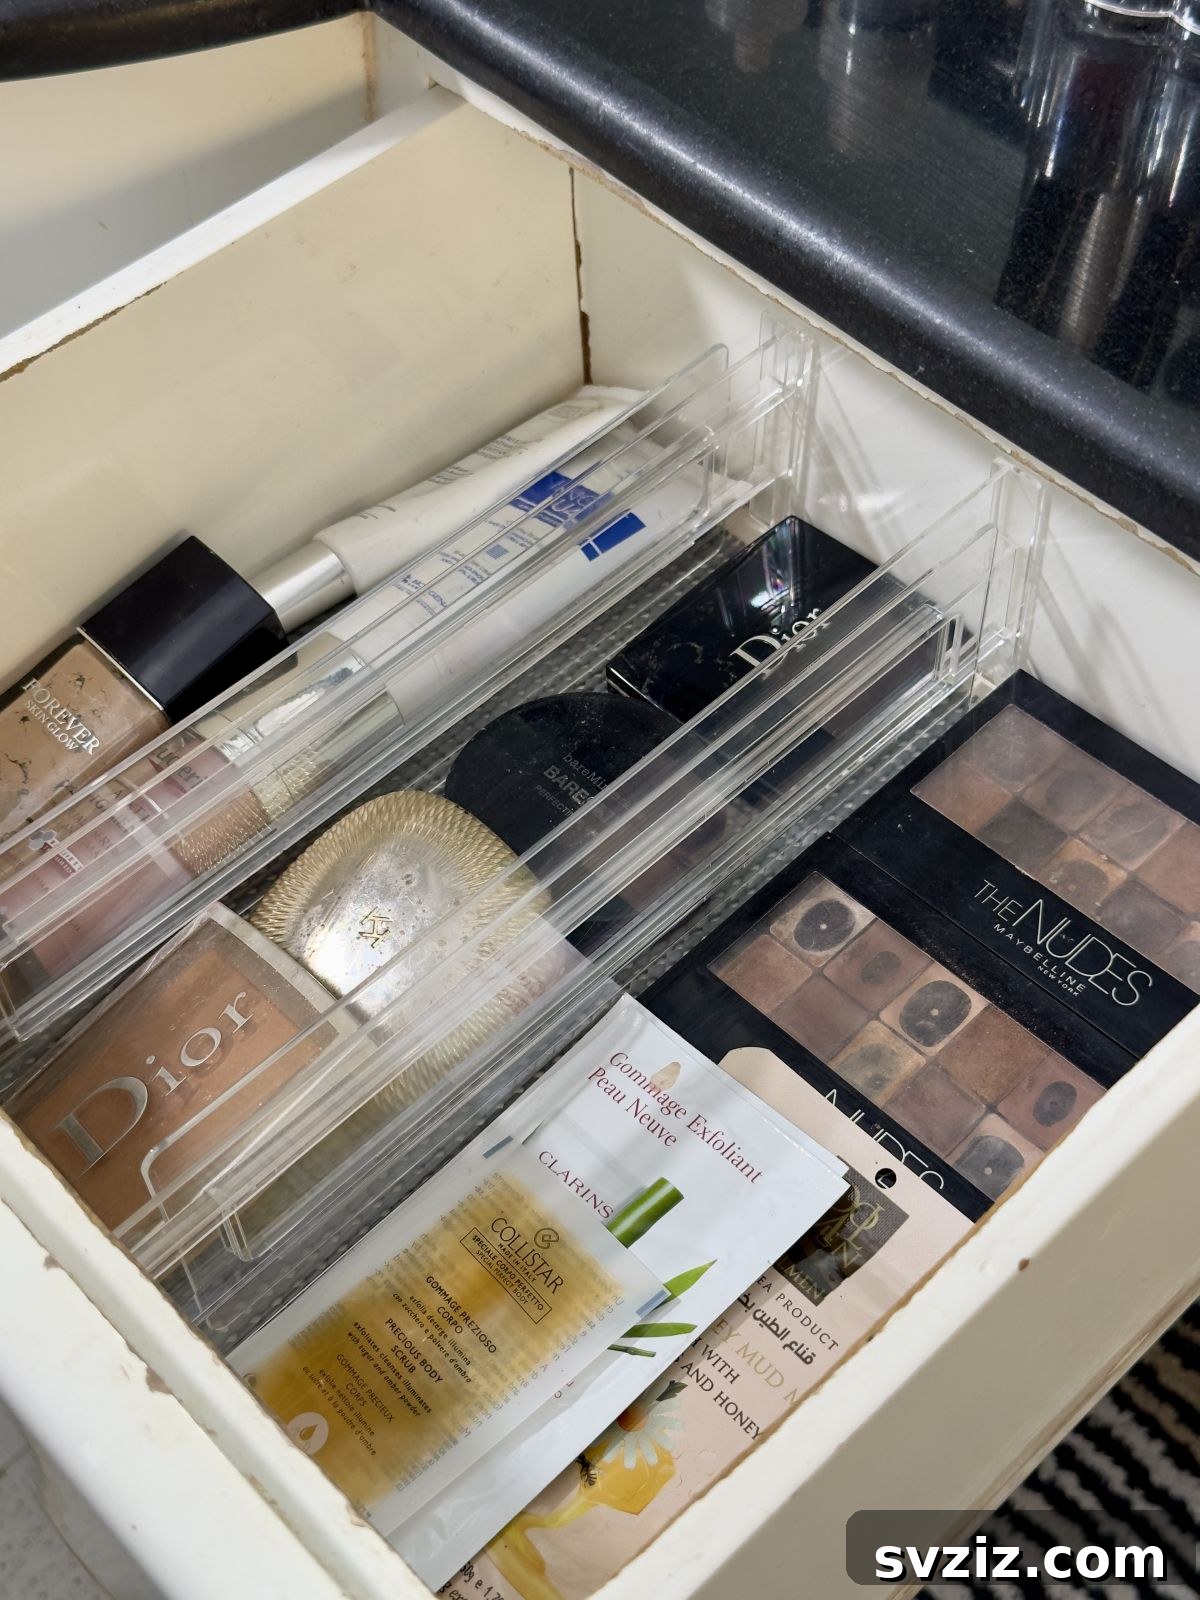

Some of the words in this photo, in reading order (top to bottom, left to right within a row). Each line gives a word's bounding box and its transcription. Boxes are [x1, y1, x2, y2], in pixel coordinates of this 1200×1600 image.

[730, 608, 831, 680] Dior
[22, 678, 100, 755] FOREVER
[25, 700, 49, 724] SKIN
[46, 721, 79, 751] GLOW
[974, 879, 1023, 921] THE
[1012, 899, 1153, 1006] NUDES
[993, 923, 1087, 993] MAYBELLINE
[1037, 965, 1056, 980] NEW
[1056, 978, 1080, 997] YORK
[54, 991, 253, 1178] Dior
[587, 1066, 627, 1103] Peau
[626, 1098, 677, 1147] Neuve
[609, 1052, 687, 1119] Gommage
[686, 1113, 764, 1184] Exfoliant
[538, 1150, 614, 1219] CLARINS
[472, 1234, 496, 1260] SPECIALE
[496, 1259, 515, 1279] CORPO
[514, 1279, 544, 1310] PERFETTO
[475, 1249, 494, 1268] SPECIAL
[493, 1267, 513, 1288] PERFECT
[512, 1288, 528, 1304] BODY
[491, 1217, 564, 1294] COLLISTAR
[497, 1242, 512, 1258] MADE
[520, 1265, 535, 1282] ITALY
[402, 1302, 425, 1328] zucchero
[425, 1273, 460, 1313] GOMMAGE
[459, 1311, 497, 1353] PREZIOSO
[425, 1313, 448, 1339] deterge
[447, 1338, 472, 1365] illumina
[436, 1305, 463, 1334] CORPO
[752, 1307, 791, 1342] الطين
[756, 1275, 773, 1293] EA
[775, 1292, 839, 1351] PRODUCT
[335, 1353, 367, 1389] GOMMAGE
[347, 1331, 359, 1344] with
[357, 1344, 374, 1363] sugar
[373, 1362, 385, 1374] and
[383, 1374, 401, 1394] amber
[399, 1394, 420, 1417] powder
[353, 1321, 380, 1352] exfoliates
[379, 1351, 403, 1379] cleanses
[401, 1378, 432, 1413] illuminates
[385, 1318, 421, 1359] PRECIOUS
[419, 1358, 442, 1384] BODY
[390, 1345, 416, 1373] SCRUB
[701, 1345, 740, 1385] WITH
[736, 1343, 784, 1389] MUD
[782, 1340, 817, 1366] قناع
[345, 1382, 367, 1406] CORPS
[681, 1362, 714, 1393] AND
[713, 1390, 763, 1441] HONEY
